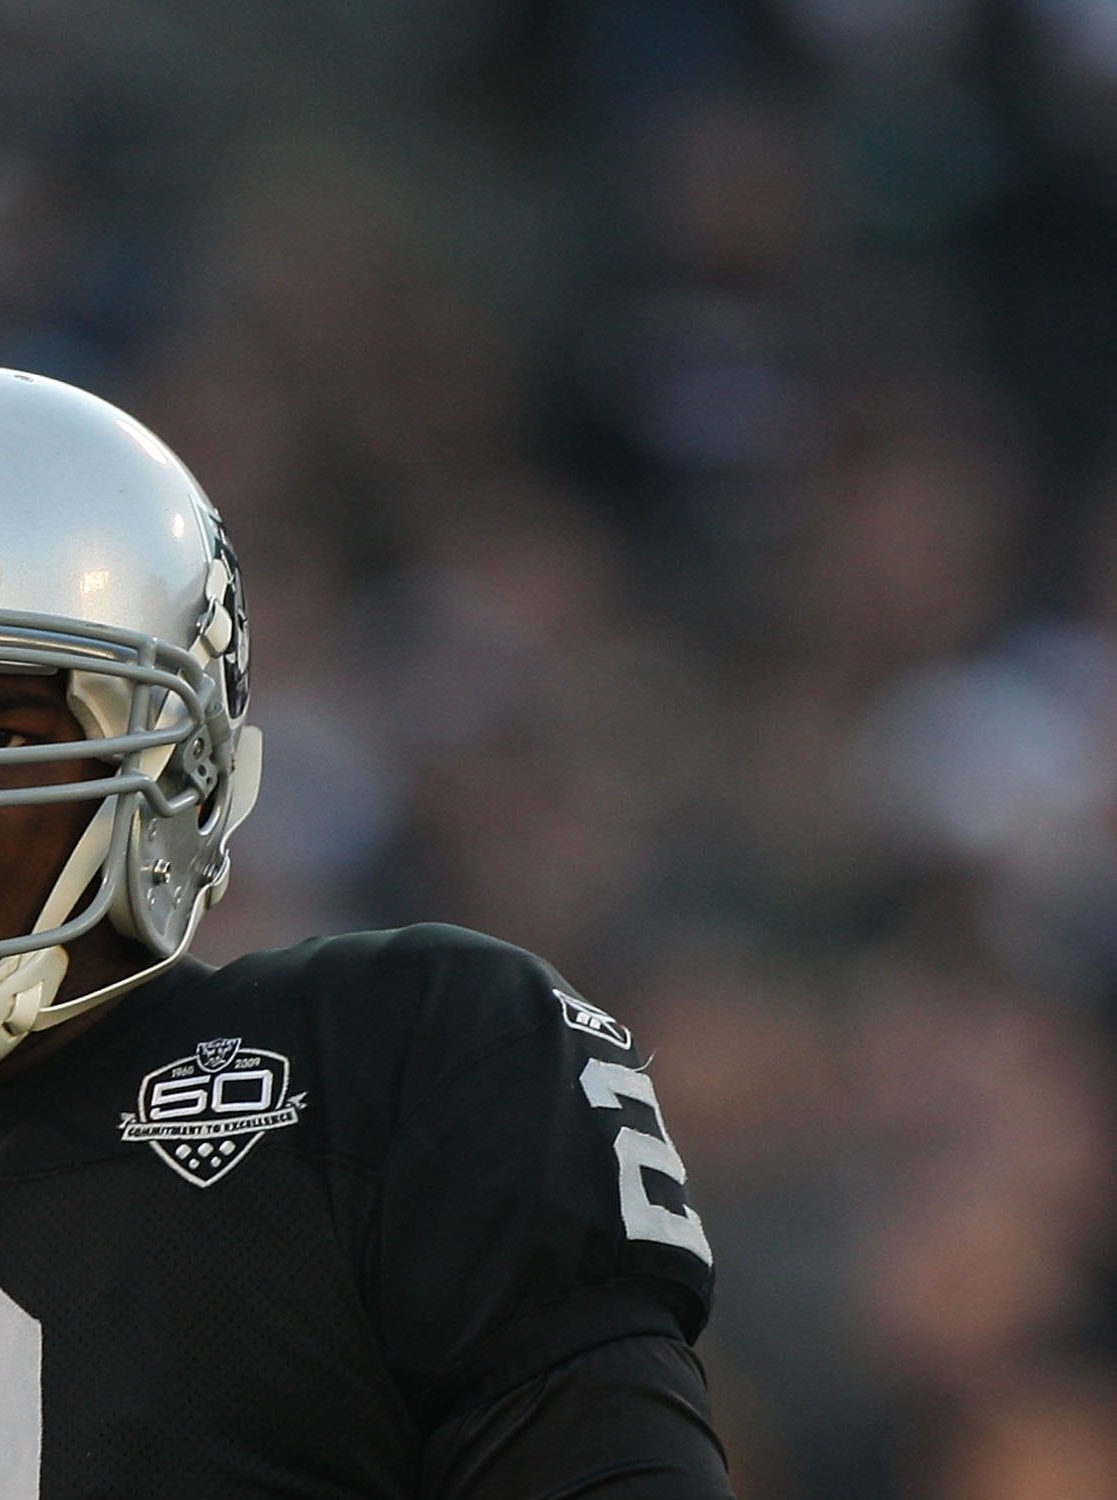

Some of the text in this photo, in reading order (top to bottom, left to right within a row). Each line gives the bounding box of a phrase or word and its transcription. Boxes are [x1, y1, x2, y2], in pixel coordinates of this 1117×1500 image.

[150, 1069, 273, 1120] 50
[128, 1111, 293, 1137] COMMITMENT TO EXCELLENCE
[579, 1058, 713, 1266] 2
